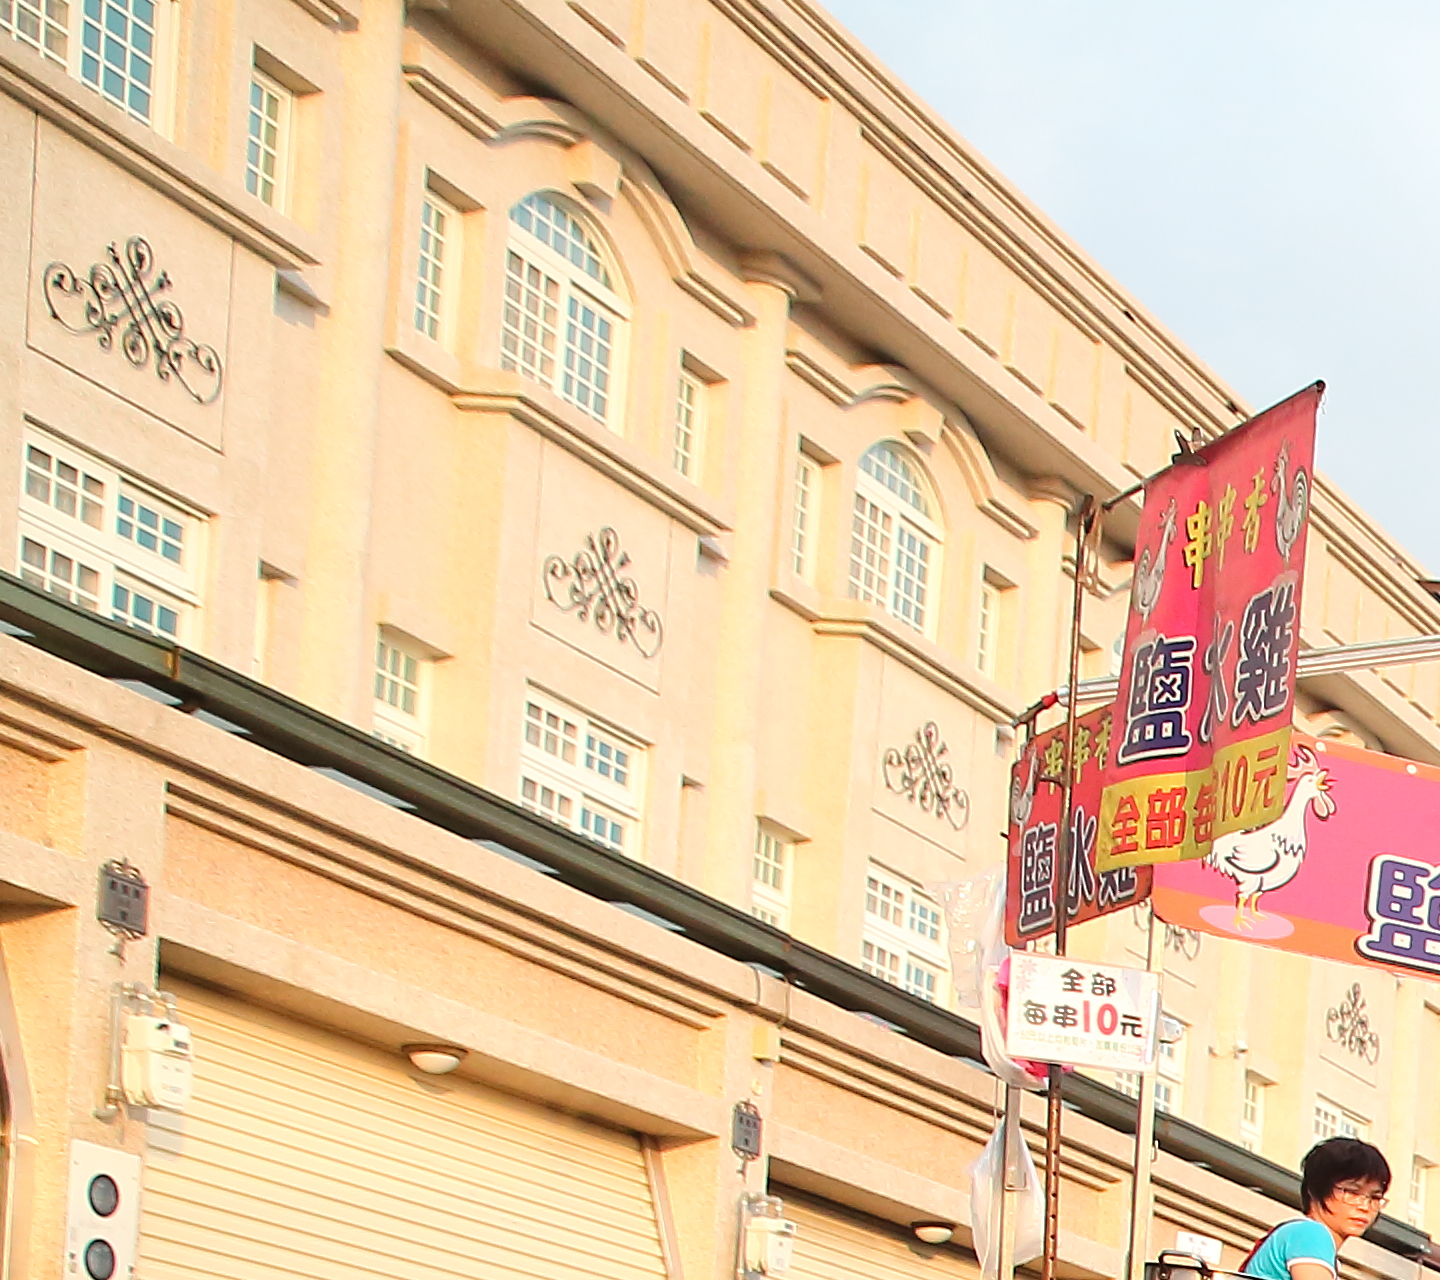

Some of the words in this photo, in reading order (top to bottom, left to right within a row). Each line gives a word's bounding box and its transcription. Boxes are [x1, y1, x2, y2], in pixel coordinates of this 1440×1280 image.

[1060, 968, 1116, 997] 全部
[1023, 999, 1143, 1038] 每串10元
